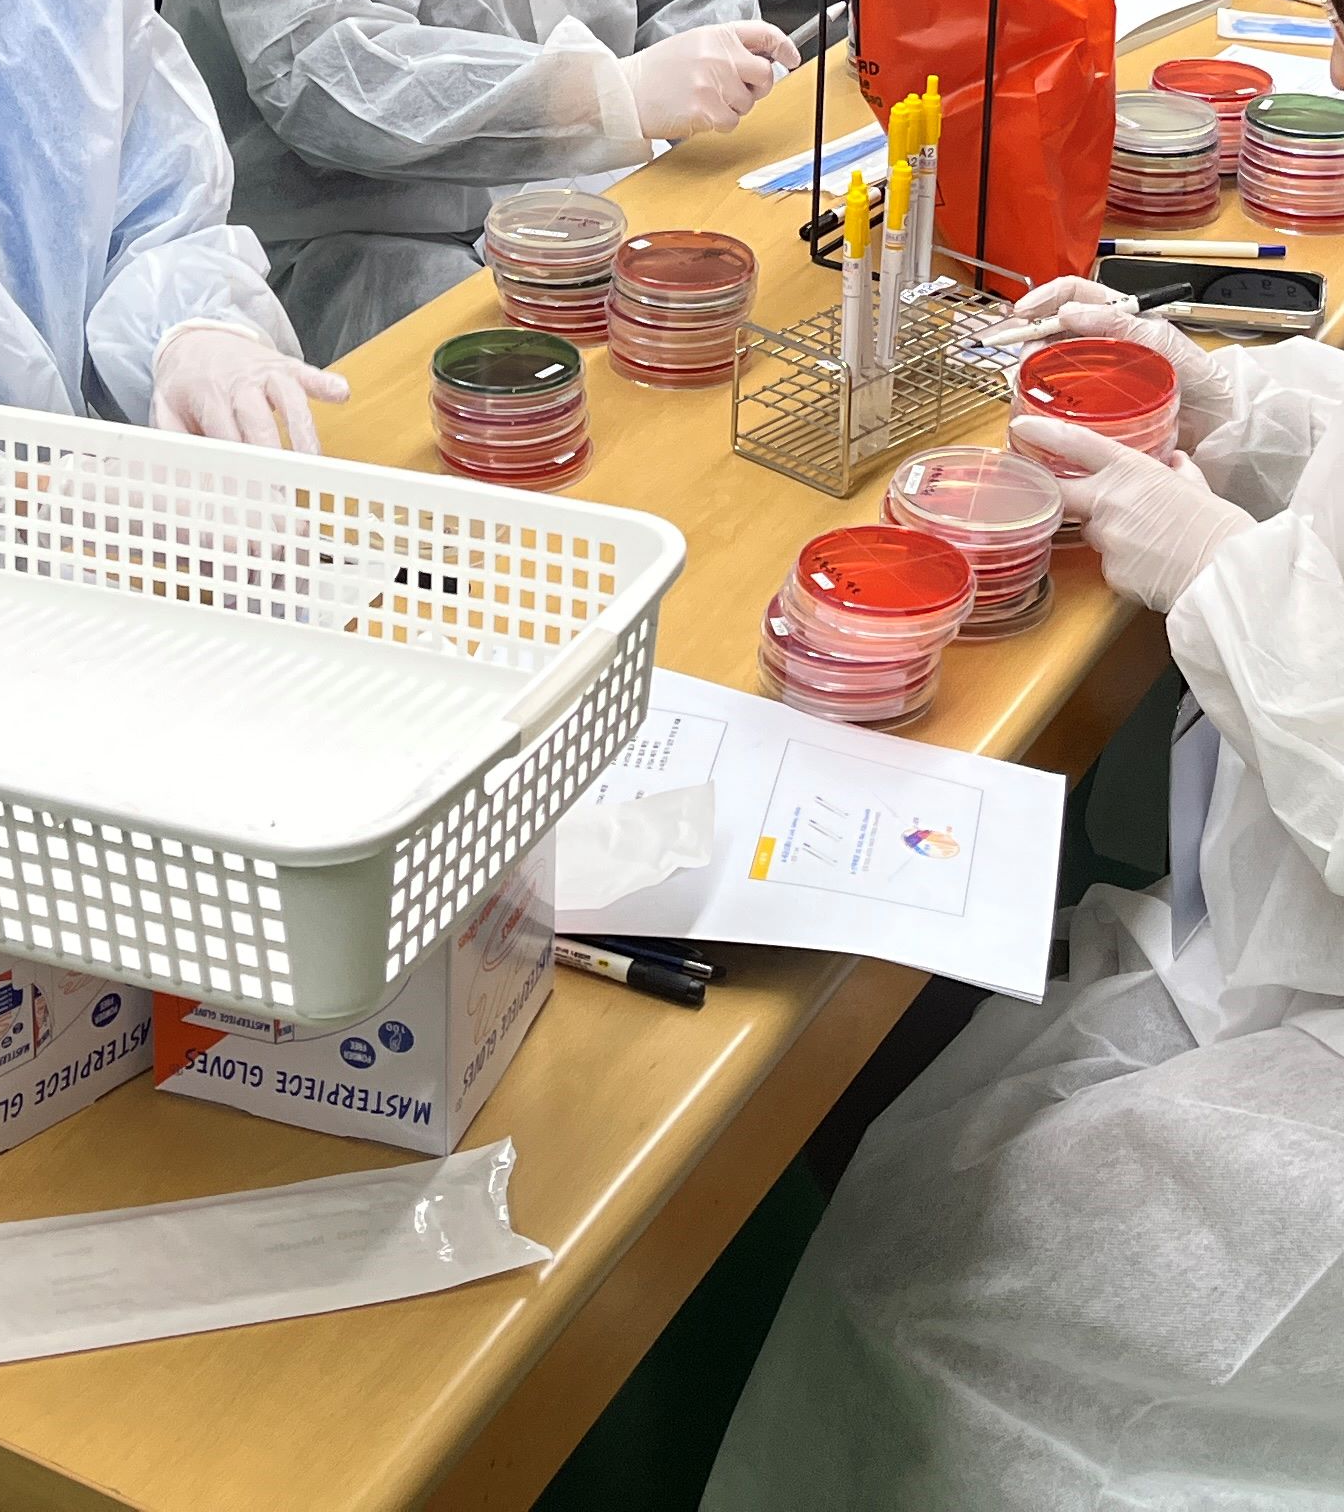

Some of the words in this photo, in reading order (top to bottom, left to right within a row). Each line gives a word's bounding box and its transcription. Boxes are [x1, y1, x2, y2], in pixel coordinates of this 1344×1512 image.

[220, 1013, 270, 1032] MASTERPIECE
[34, 1017, 152, 1107] ASTERPIECE
[343, 1050, 373, 1065] POWDER
[349, 1040, 367, 1052] FREE
[463, 1029, 497, 1096] GLOVES
[185, 1047, 264, 1088] GLOVES
[276, 1070, 433, 1126] MASTERPIECE
